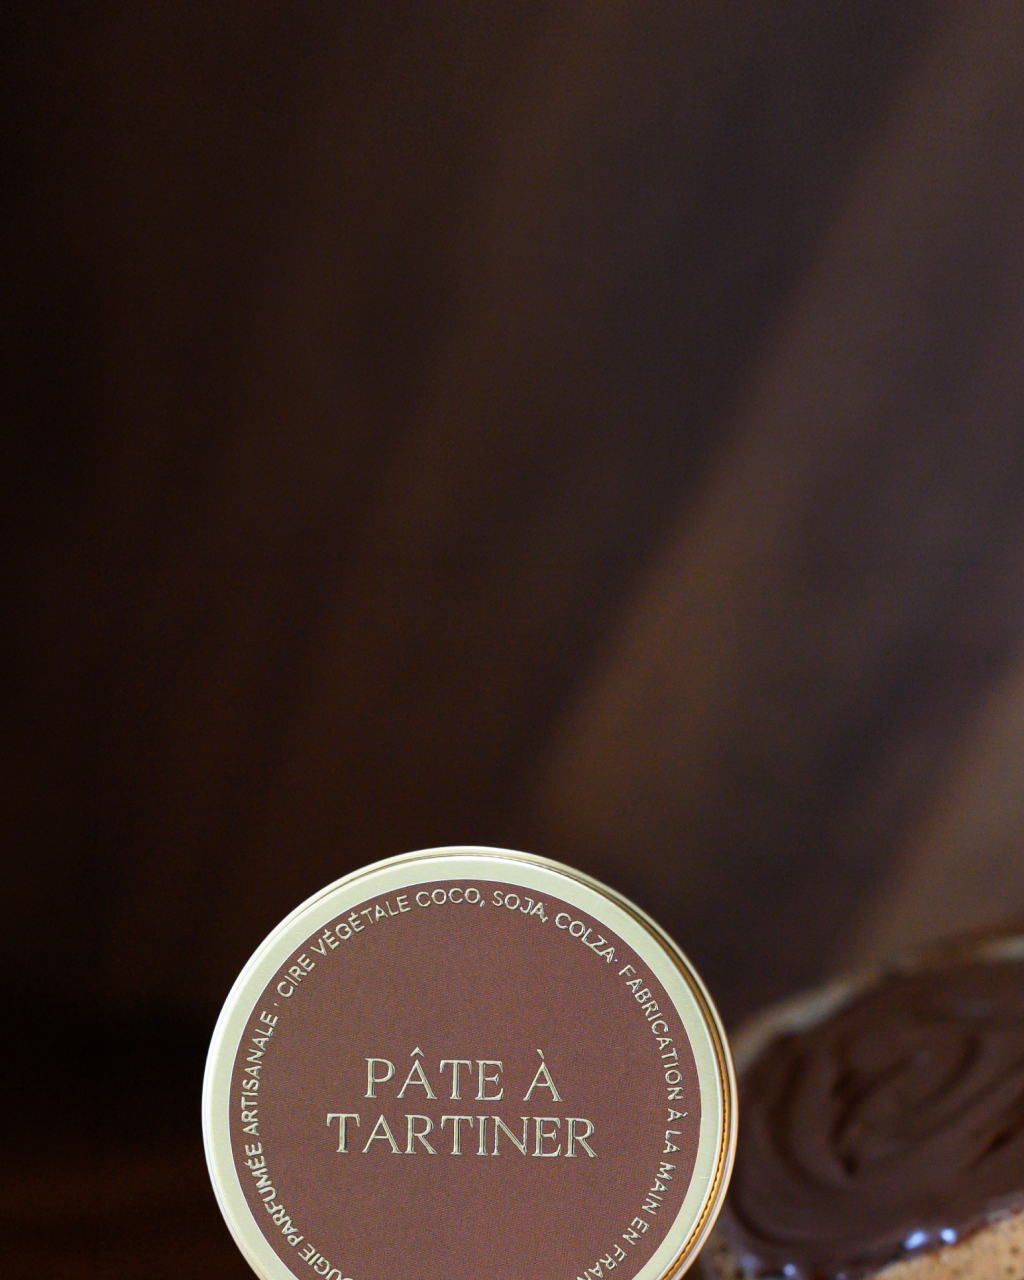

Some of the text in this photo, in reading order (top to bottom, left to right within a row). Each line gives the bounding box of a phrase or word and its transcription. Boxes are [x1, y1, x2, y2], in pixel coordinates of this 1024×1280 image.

[416, 887, 485, 908] COCO,
[310, 895, 411, 956] VÉGÉTALE
[277, 954, 316, 998] CIRE
[618, 964, 684, 1100] FABRICATION
[241, 1010, 279, 1136] ARTISANALE
[364, 1046, 563, 1102] PÂTE À
[326, 1113, 599, 1159] TARTINER
[667, 1108, 689, 1122] À
[663, 1129, 683, 1154] LA
[244, 1142, 304, 1247] PARFUMÉE
[641, 1161, 677, 1215] MAIN
[622, 1216, 650, 1246] EN
